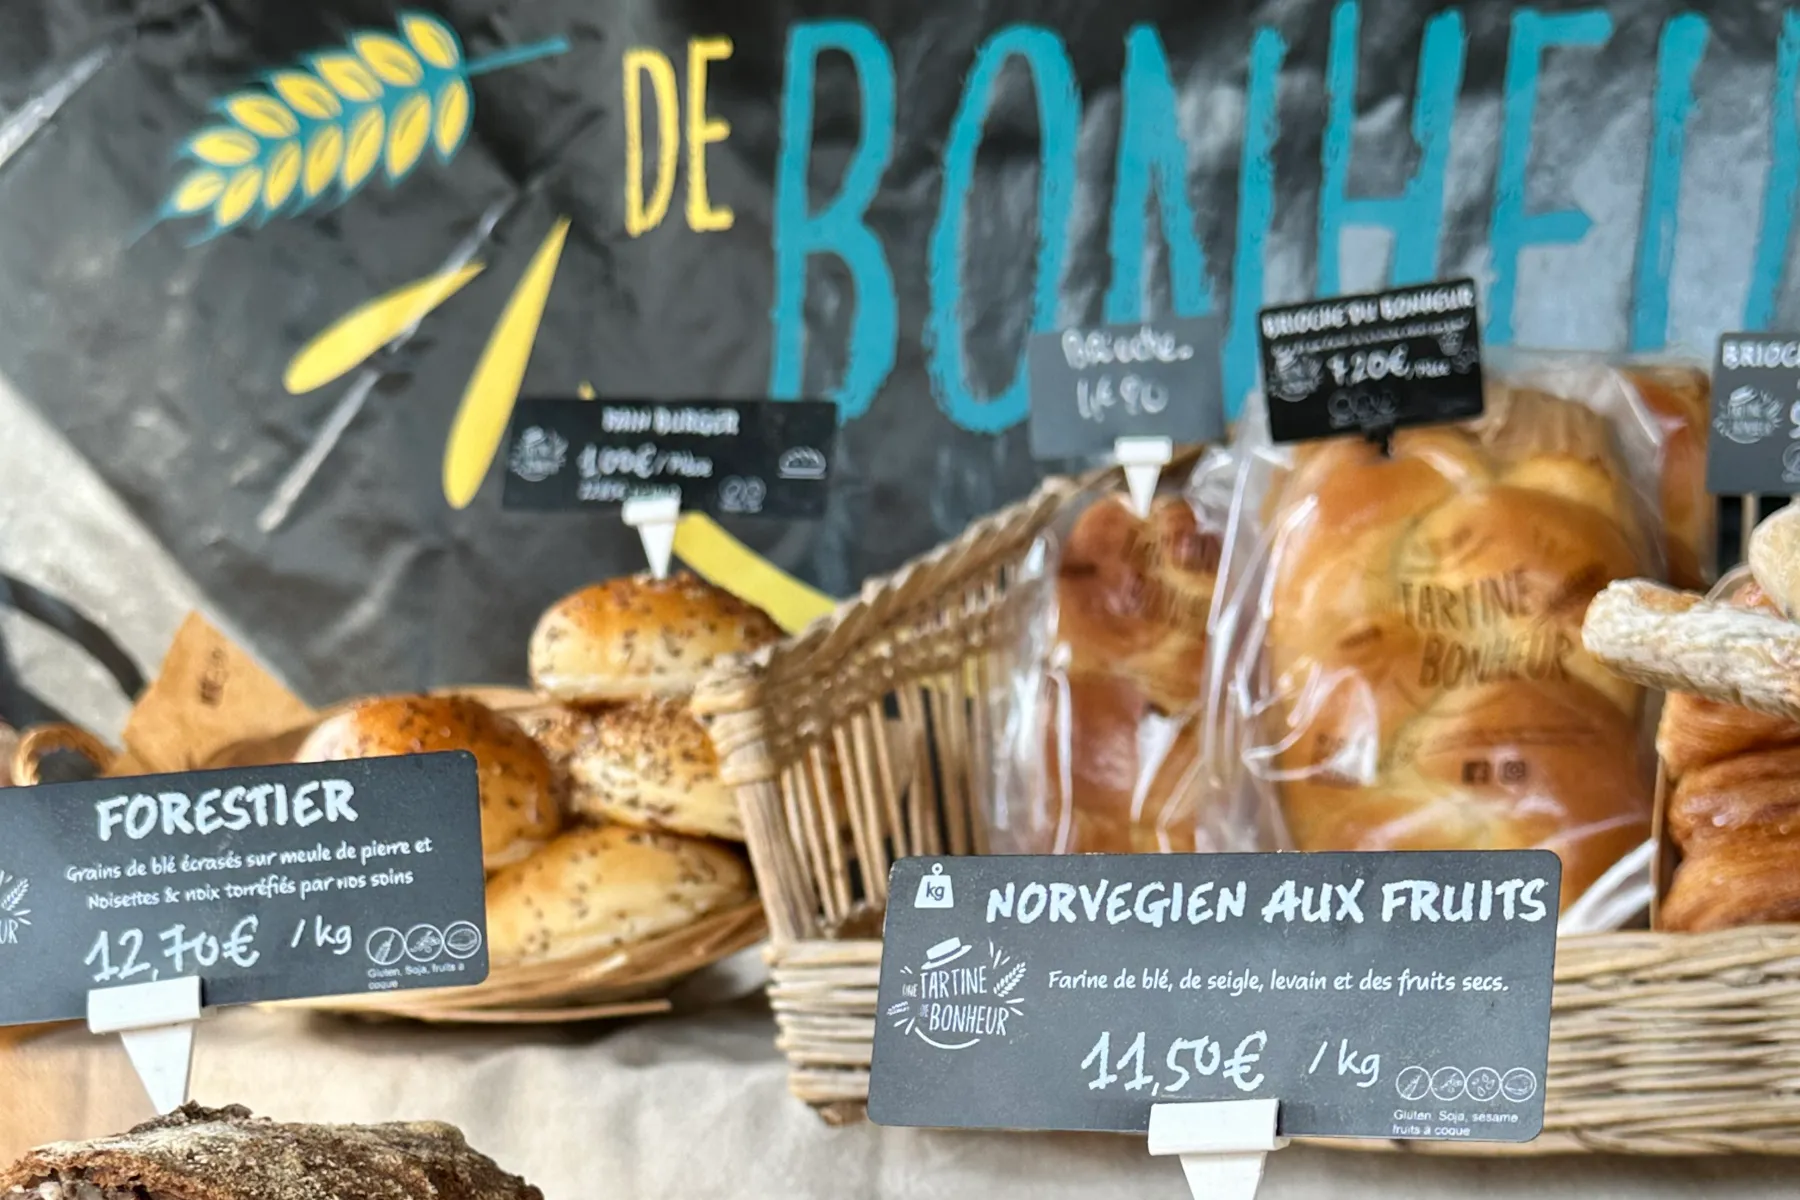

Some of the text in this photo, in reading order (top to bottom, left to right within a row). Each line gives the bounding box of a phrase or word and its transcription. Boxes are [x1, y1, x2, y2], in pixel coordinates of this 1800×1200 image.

[623, 34, 735, 237] DE
[1722, 339, 1800, 369] BRIOC
[95, 778, 359, 841] FORESTIER
[66, 837, 433, 882] Grains de blé écrasés sur meule de pierre et
[88, 890, 160, 910] Noisettes
[164, 886, 181, 903] &
[185, 884, 220, 901] noix
[300, 876, 335, 900] par
[336, 875, 367, 890] nos
[370, 868, 414, 887] soins
[925, 883, 945, 901] kg
[986, 878, 1548, 927] NORVEGIEN AUX FRUITS
[84, 914, 260, 982] 12,70€
[920, 966, 987, 999] TARTINE
[1048, 967, 1509, 996] Farine de blé, de seigle, levain et des fruits secs.
[929, 1002, 1009, 1036] BONHEUR
[1081, 1030, 1267, 1096] 11,50€
